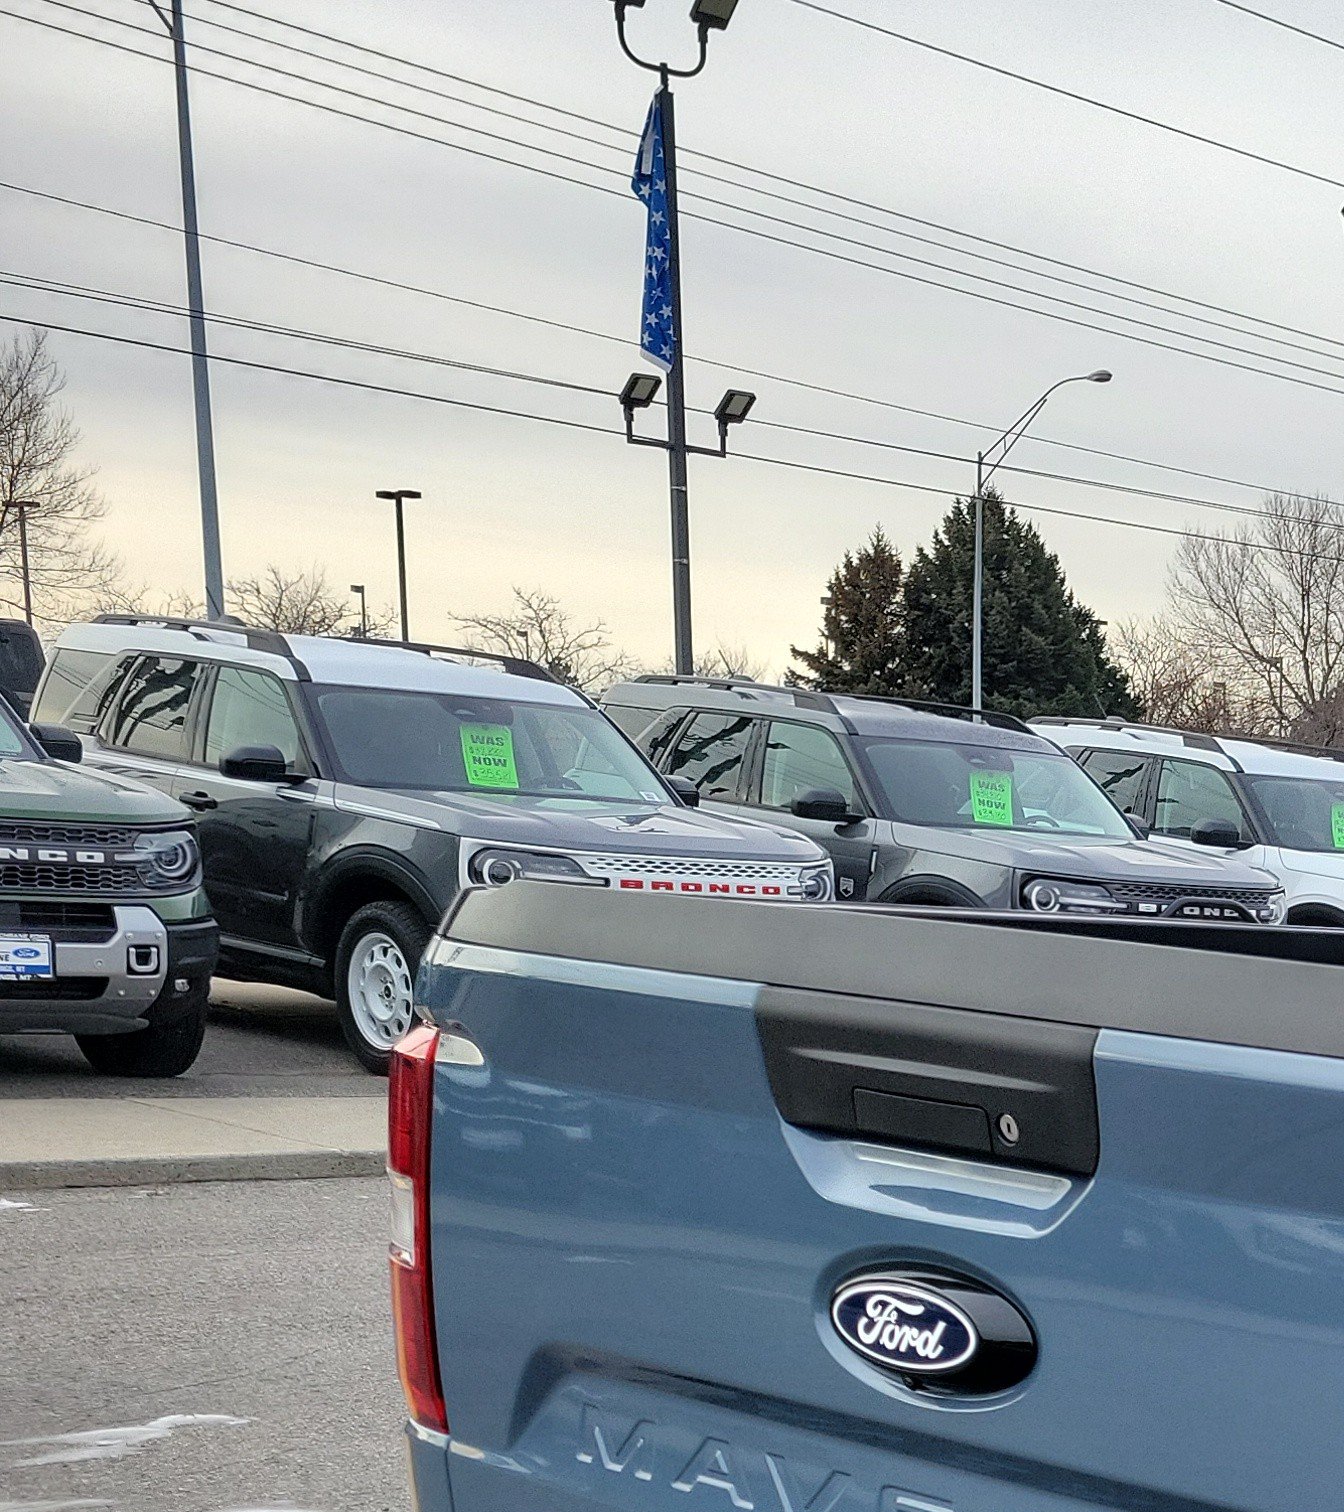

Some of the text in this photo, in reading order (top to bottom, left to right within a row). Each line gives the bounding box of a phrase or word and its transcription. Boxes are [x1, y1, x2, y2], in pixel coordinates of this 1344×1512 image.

[471, 734, 504, 746] WAS
[472, 756, 507, 767] NOW
[977, 798, 1006, 810] NOW
[620, 879, 781, 895] BRONCO
[858, 1294, 947, 1358] Ford
